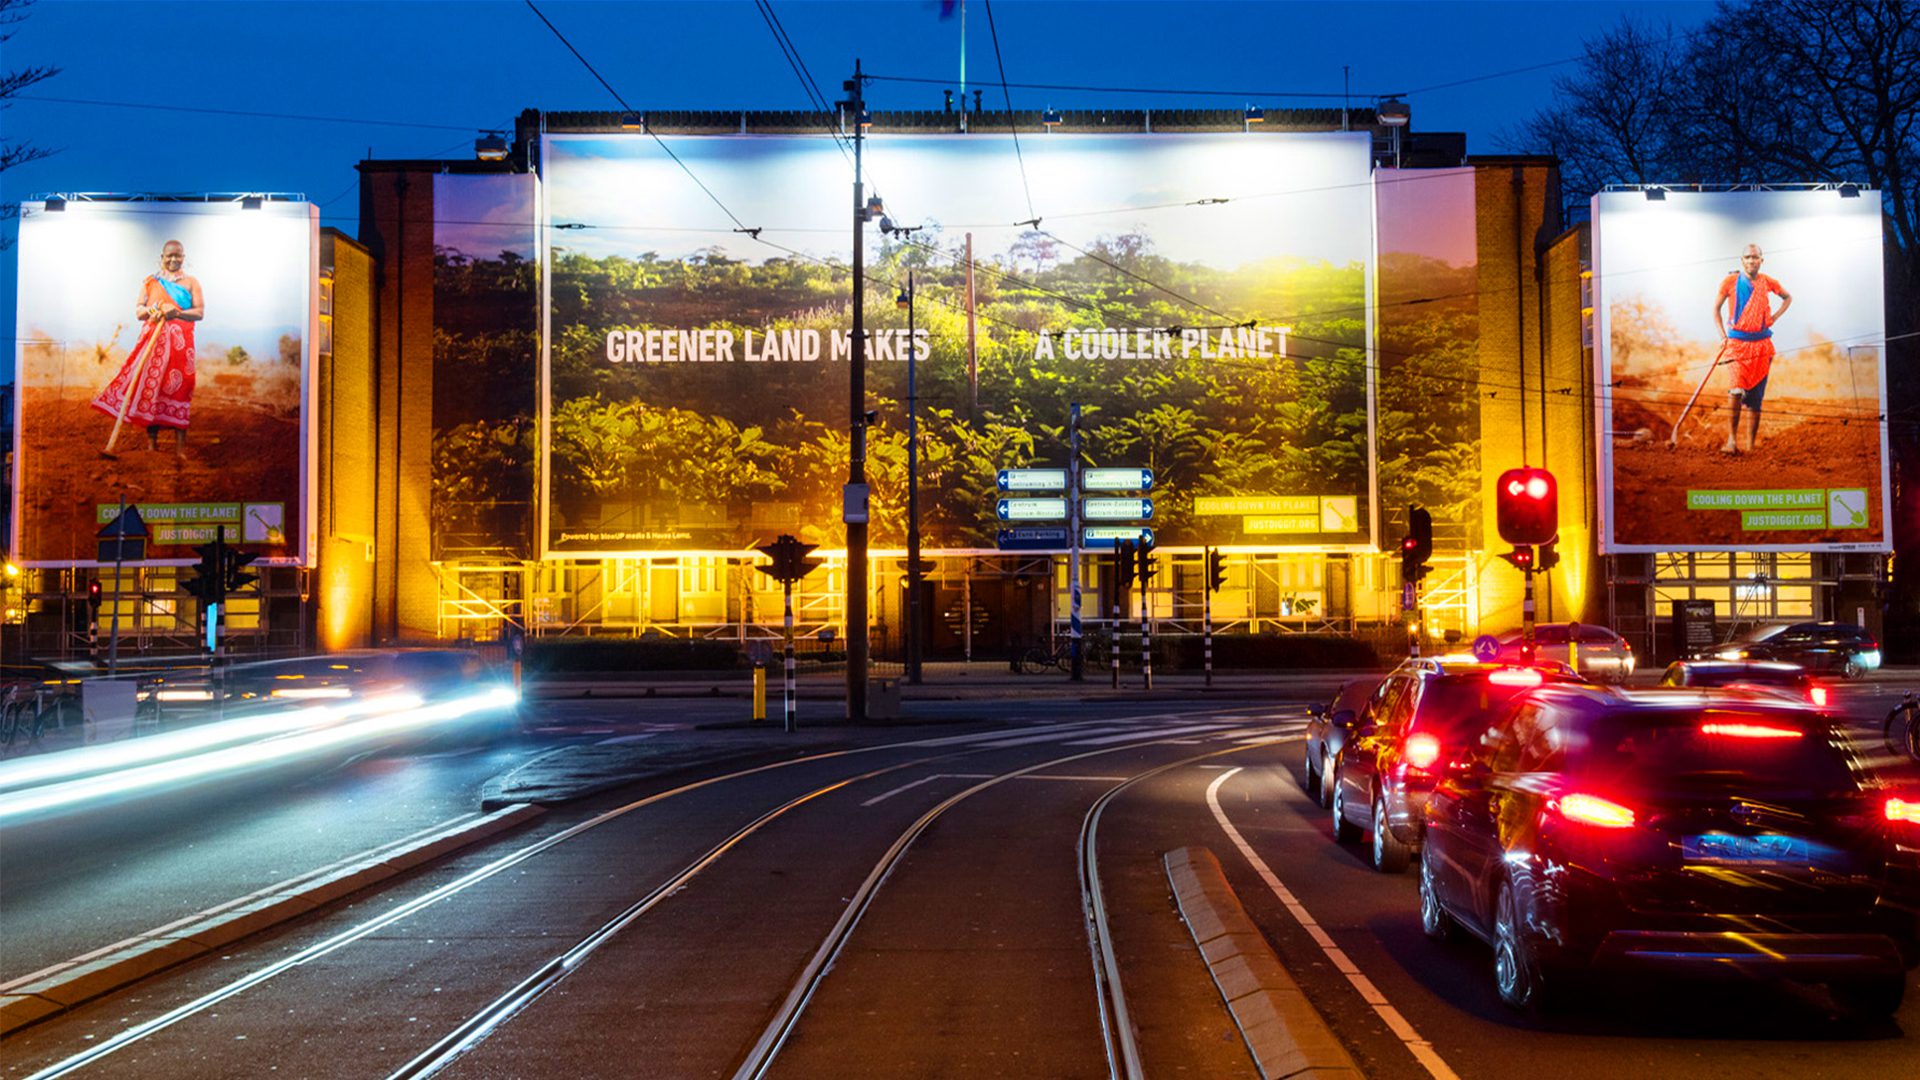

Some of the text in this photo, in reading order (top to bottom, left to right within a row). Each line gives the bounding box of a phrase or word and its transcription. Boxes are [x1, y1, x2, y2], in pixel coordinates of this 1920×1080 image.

[606, 326, 1292, 363] GREENER LAND MAKES A COOLER PLANET
[1693, 493, 1821, 505] COOLING DOWN THE PLANET
[1200, 500, 1316, 511] COOLING DOWN THE PLANET
[146, 507, 177, 518] DOWN
[180, 507, 197, 518] THE
[200, 506, 238, 518] PLANET
[1248, 519, 1316, 529] JUSTDIGGIT.ORG
[1747, 515, 1823, 526] JUSTDIGGIT.ORG
[159, 528, 237, 540] JUSTDIGGIT.RG
[561, 532, 589, 540] Powered
